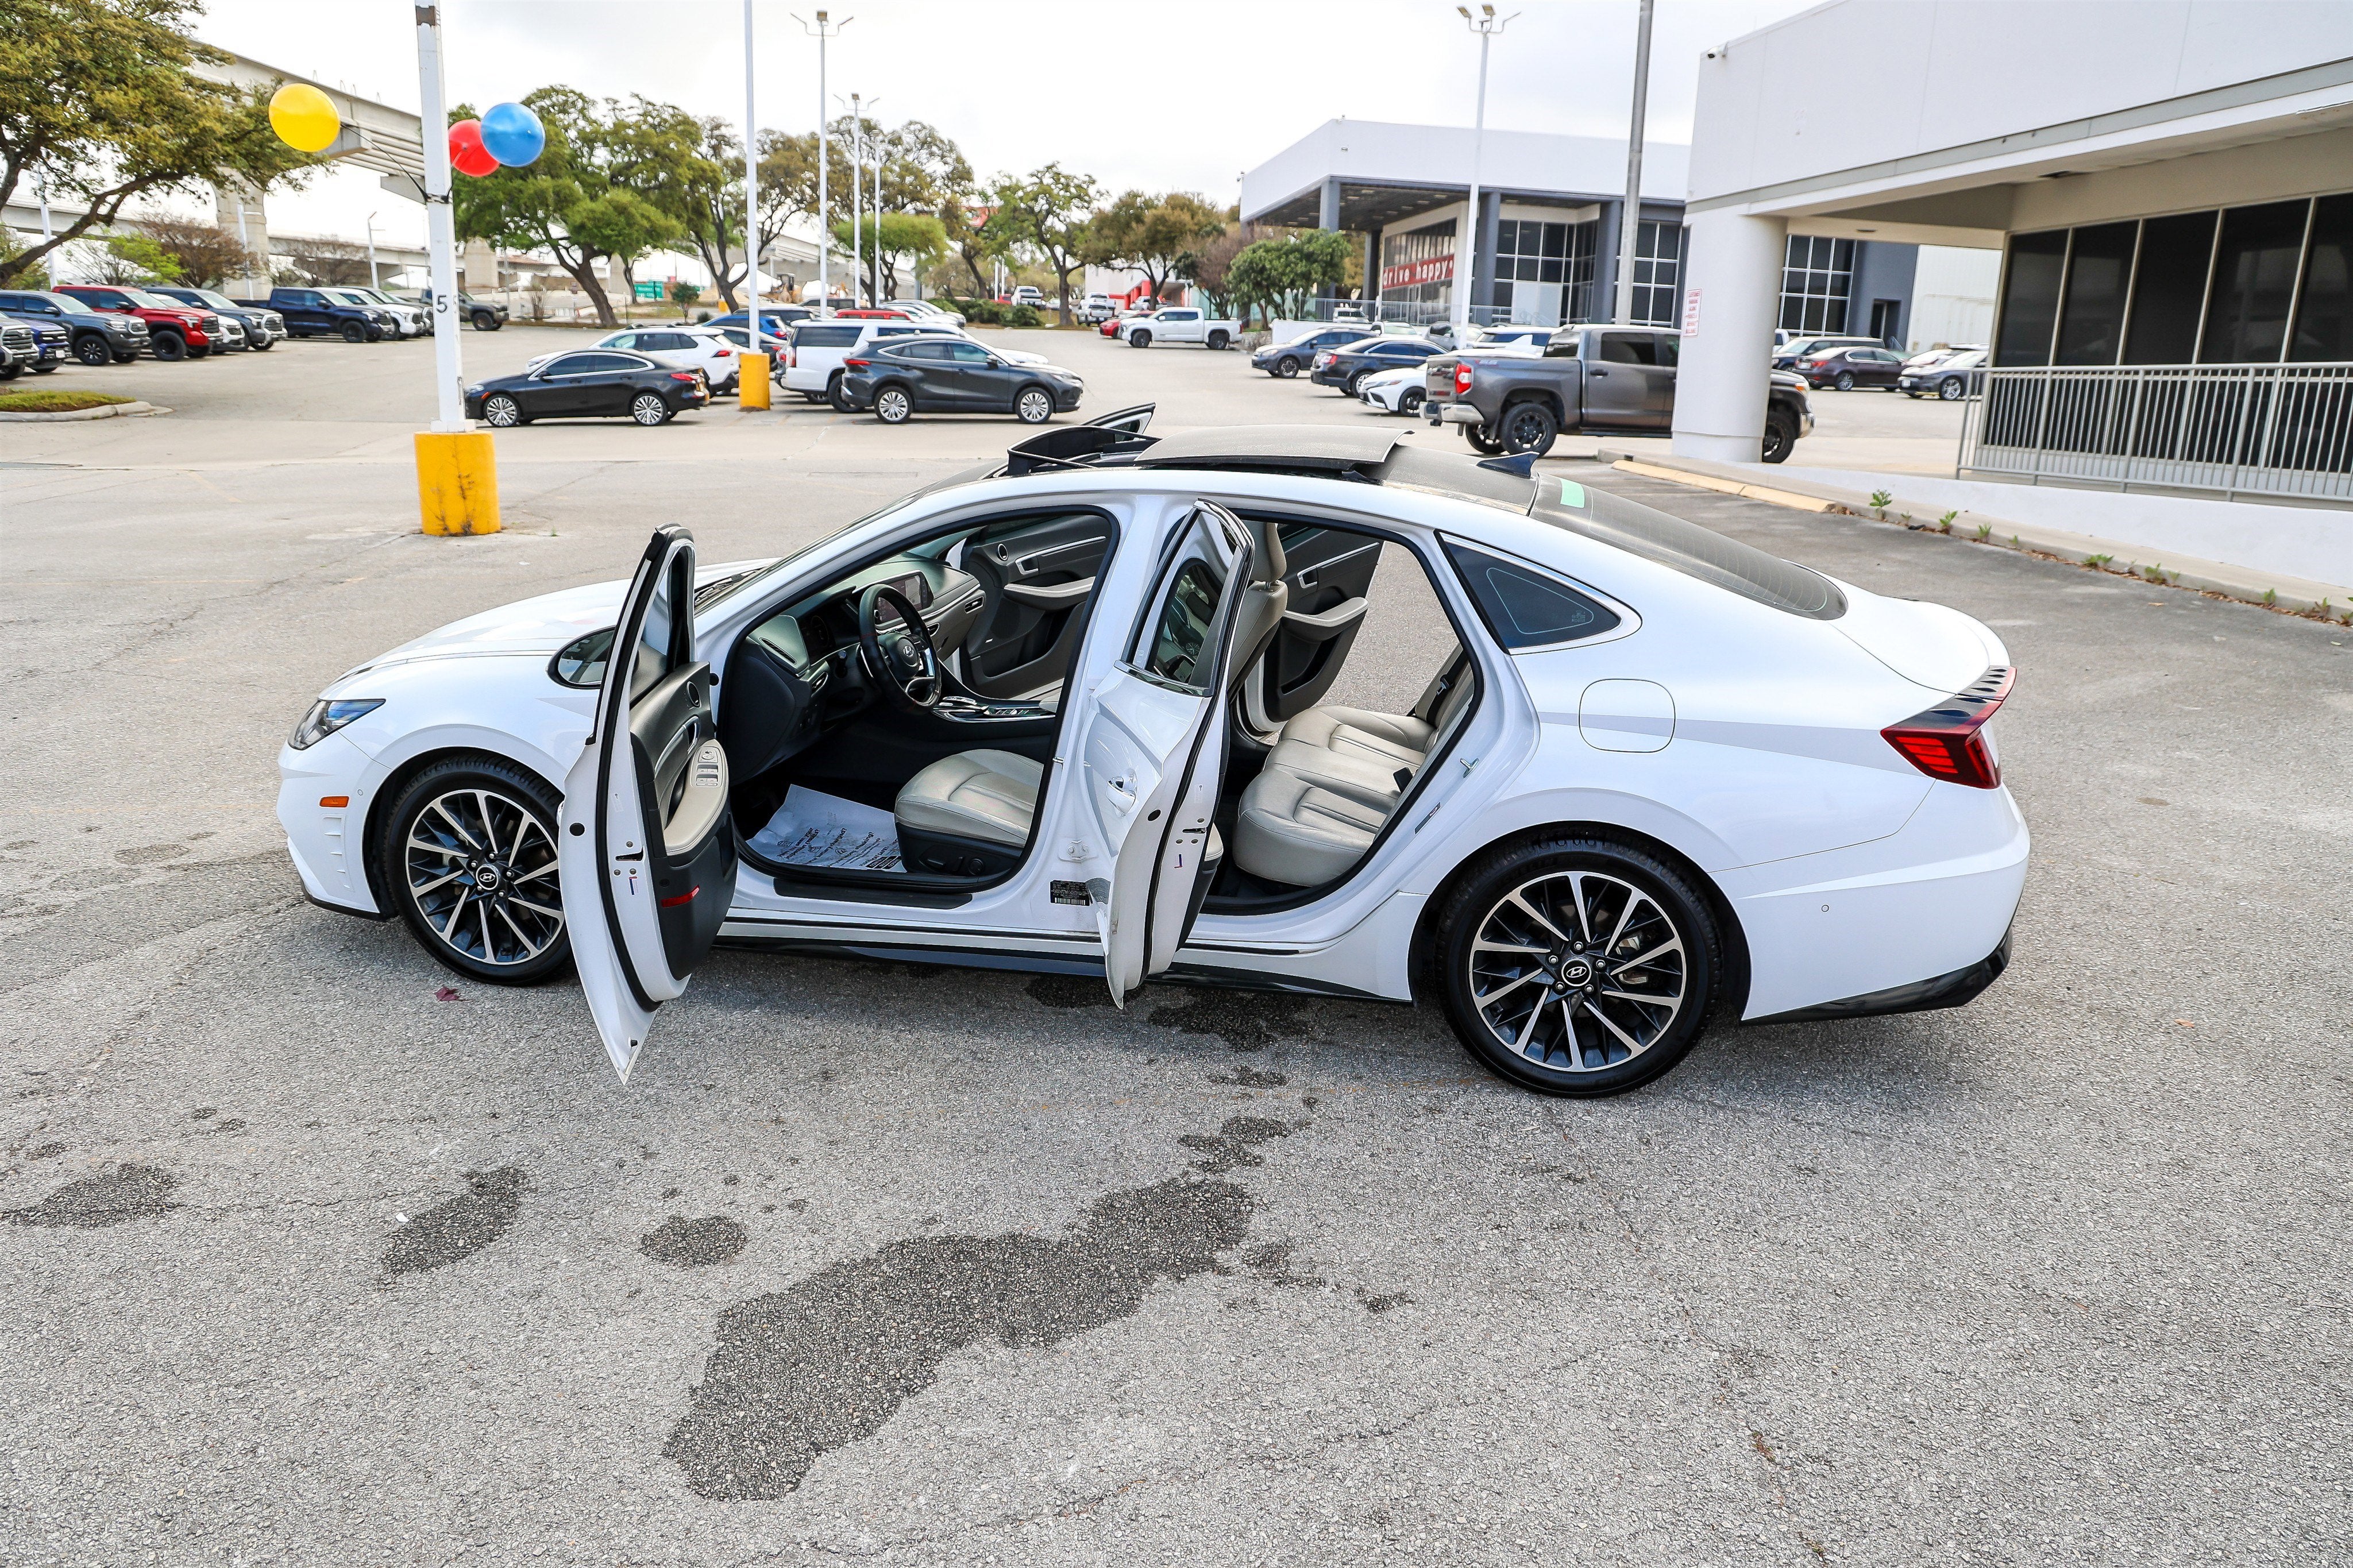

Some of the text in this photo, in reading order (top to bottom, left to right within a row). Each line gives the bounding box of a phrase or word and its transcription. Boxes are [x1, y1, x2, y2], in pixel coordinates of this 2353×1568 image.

[1383, 260, 1448, 285] drive happy
[437, 295, 448, 314] 5
